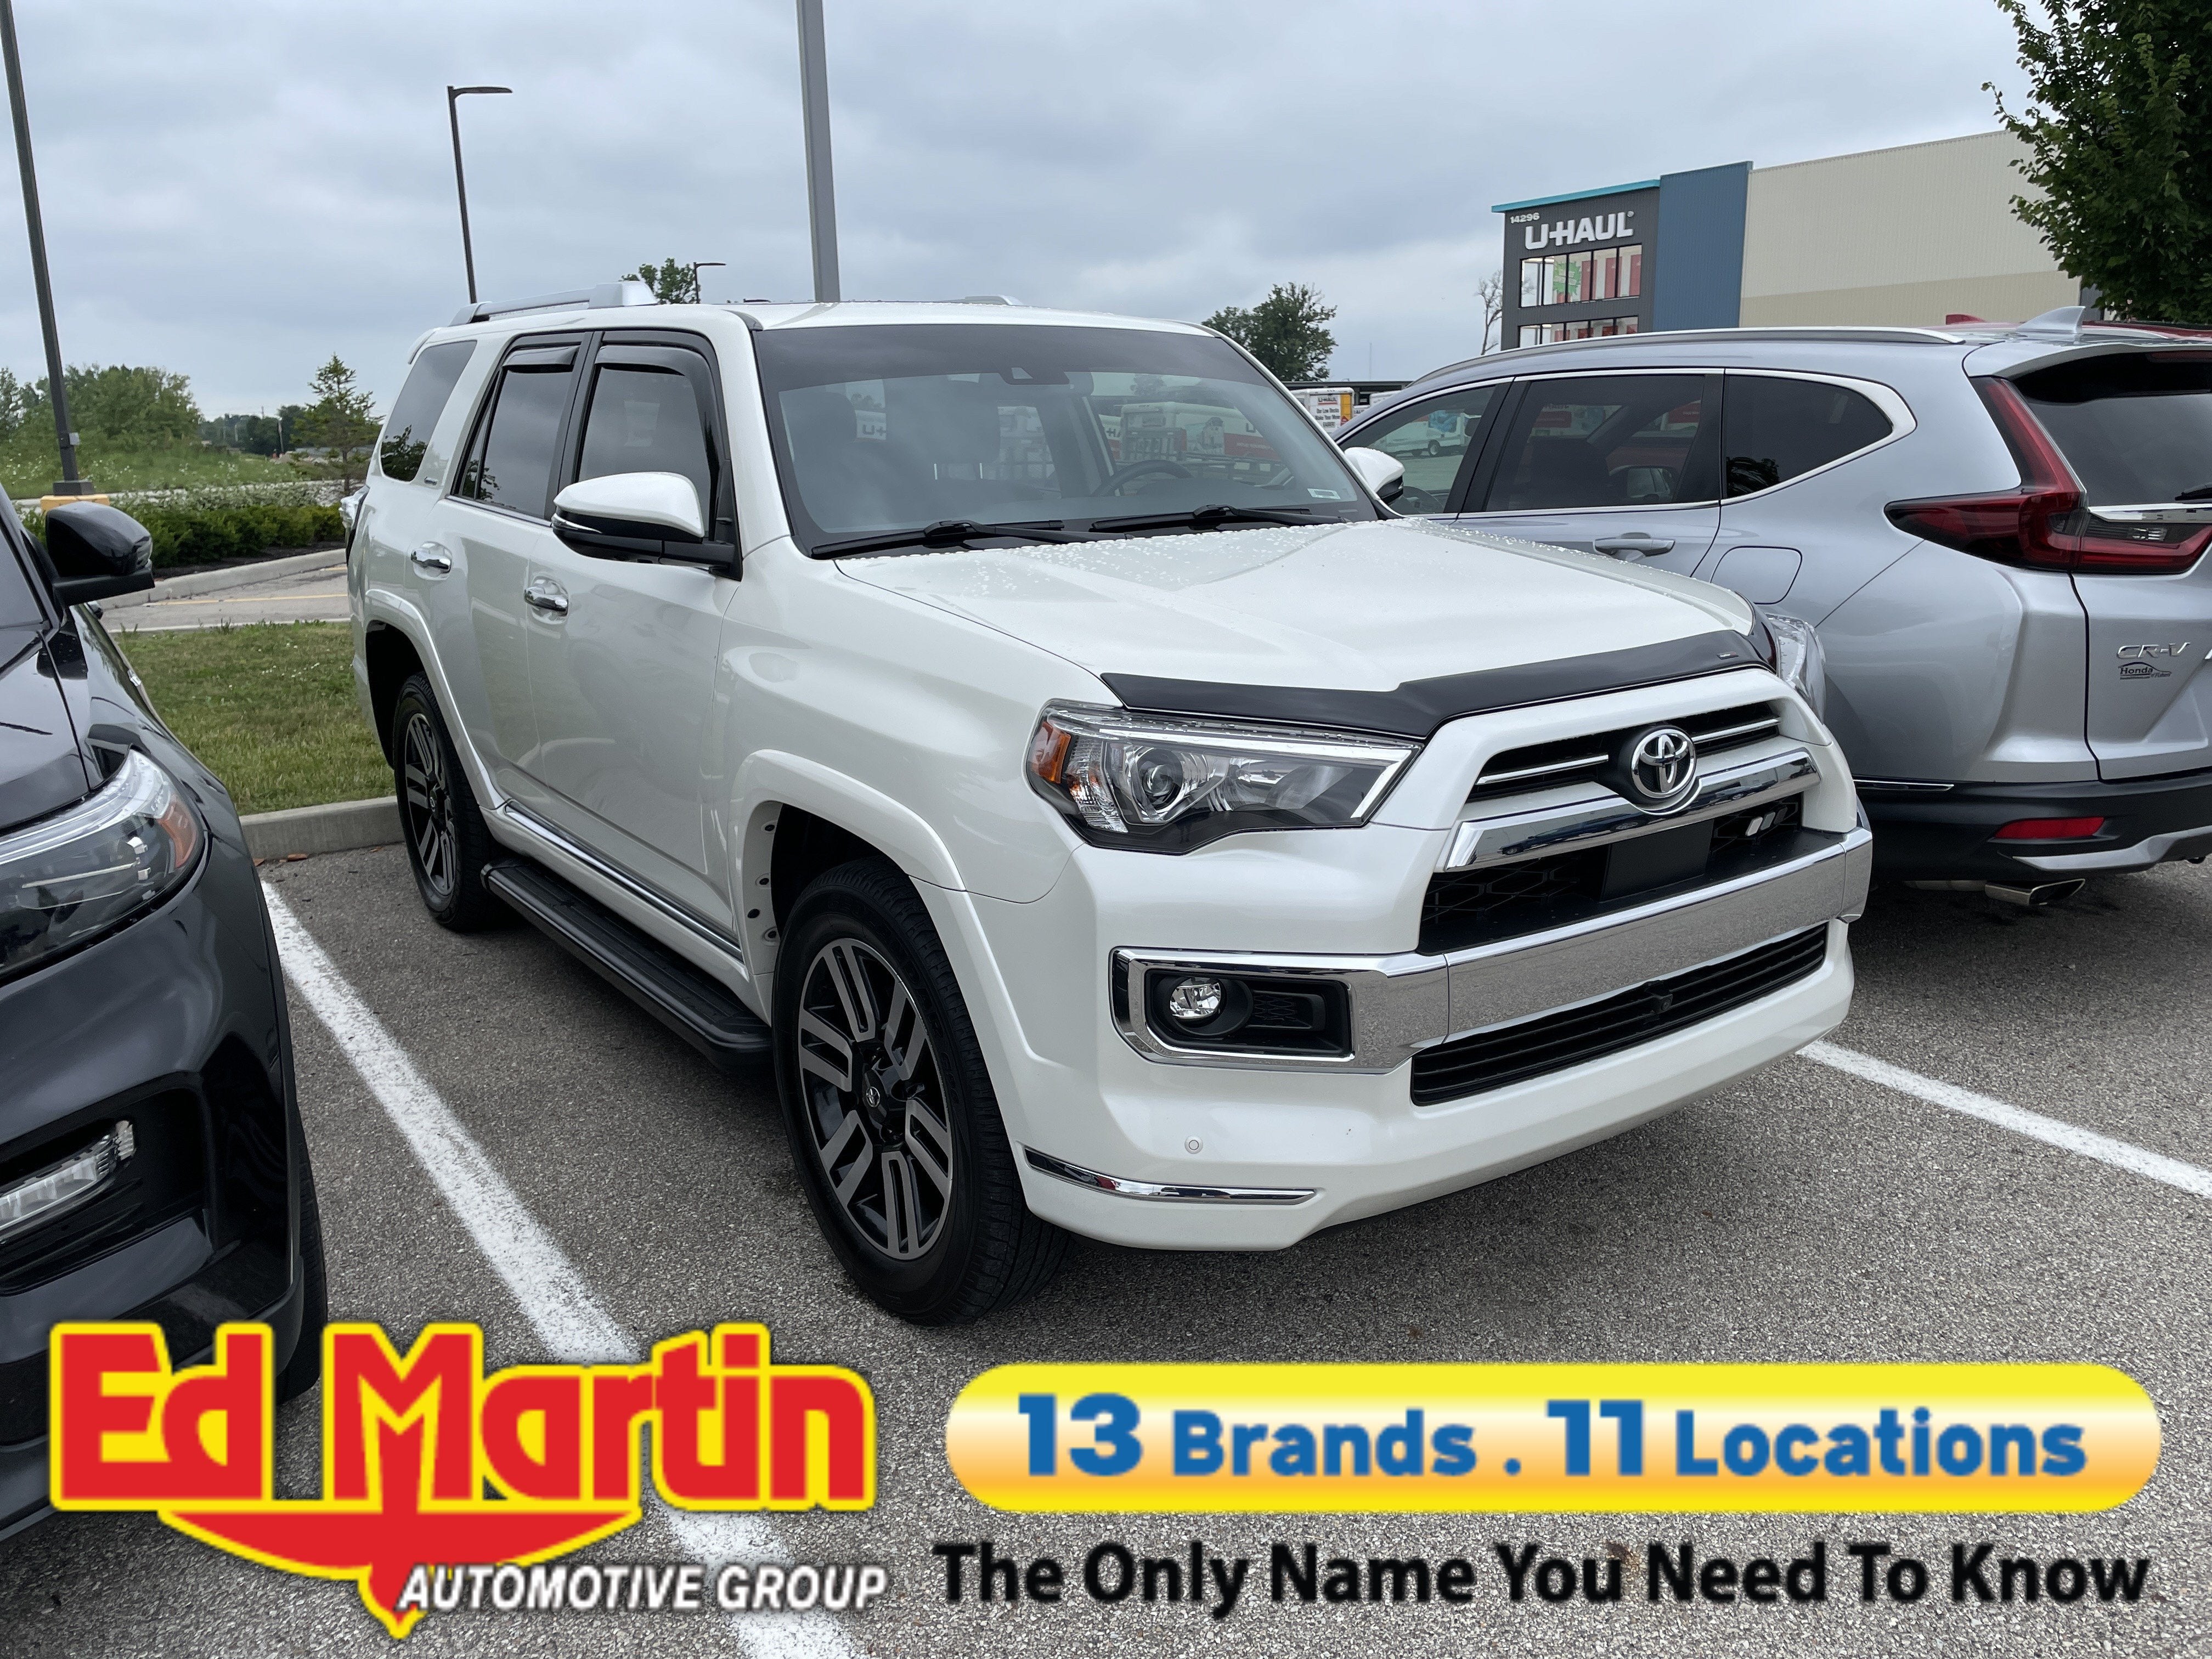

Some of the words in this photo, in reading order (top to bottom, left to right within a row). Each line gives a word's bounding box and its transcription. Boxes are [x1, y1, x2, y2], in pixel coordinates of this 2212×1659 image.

[1510, 212, 1541, 224] 14296
[1525, 211, 1635, 250] U-HAUL
[2117, 642, 2191, 659] CR-V
